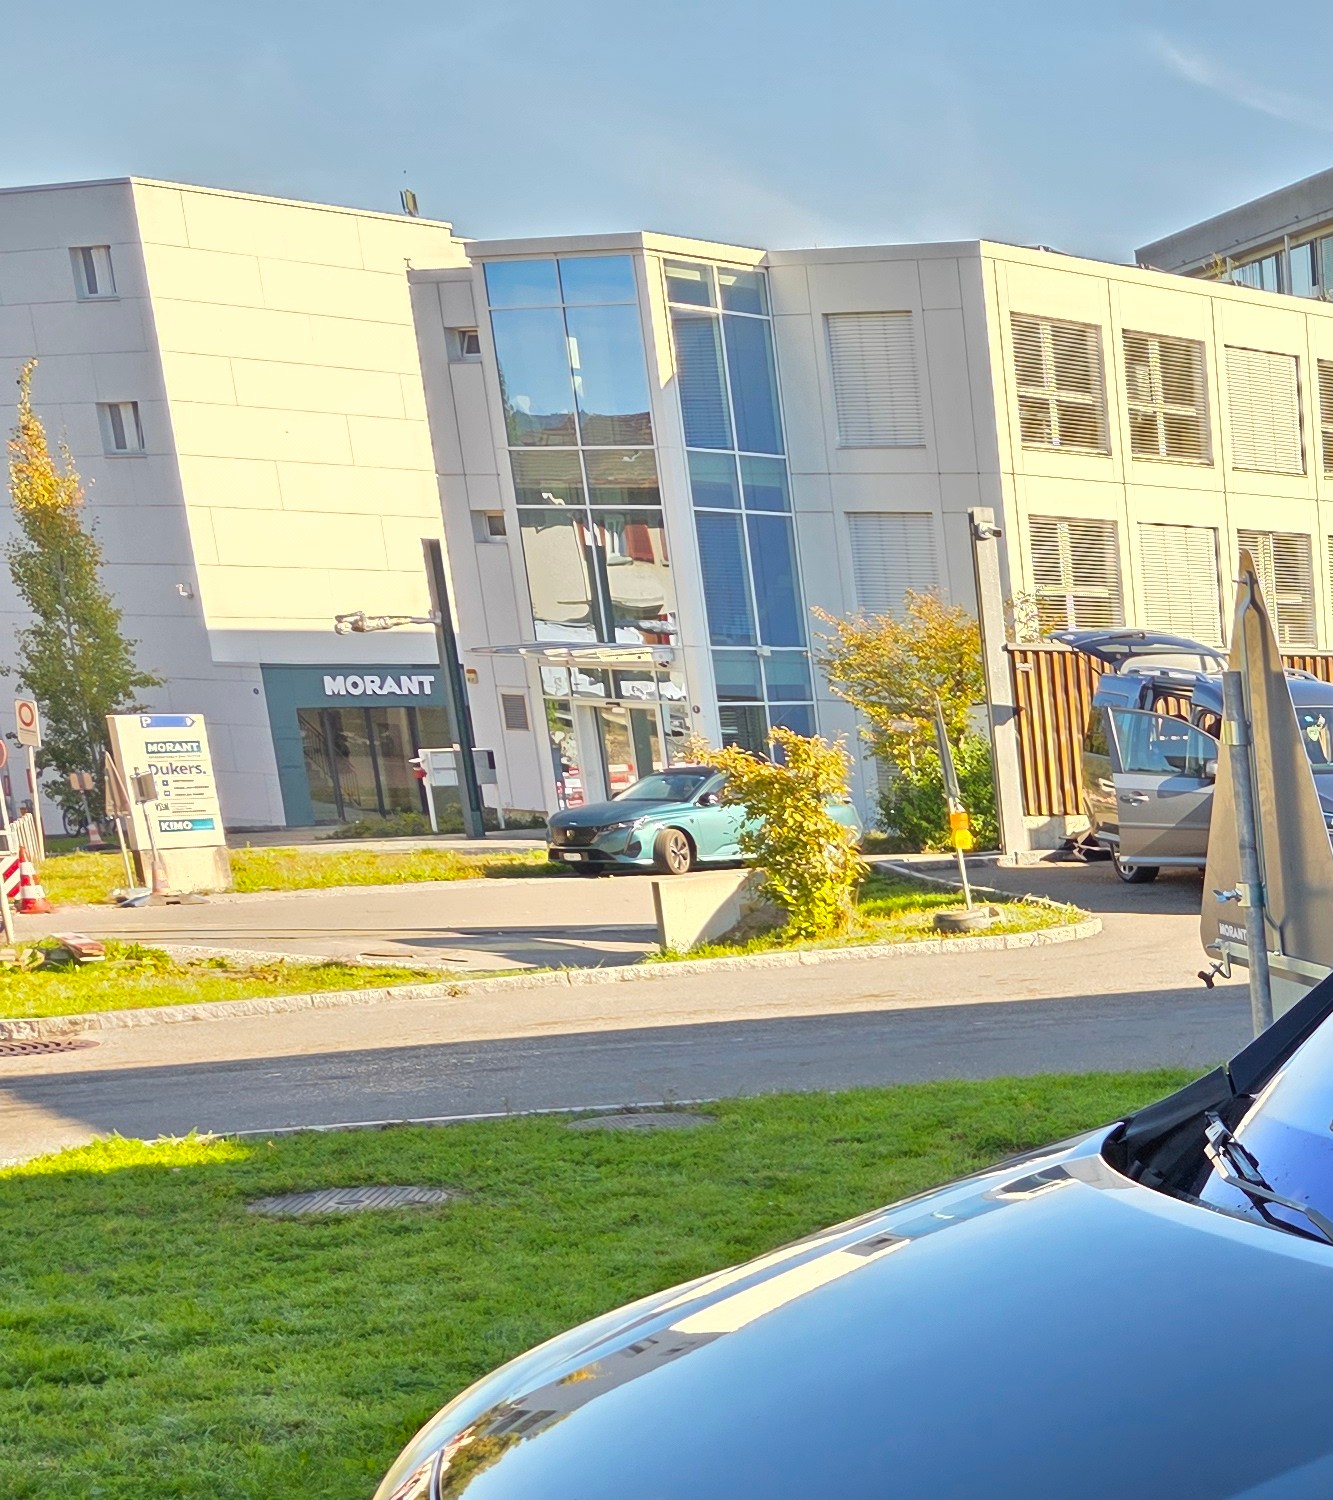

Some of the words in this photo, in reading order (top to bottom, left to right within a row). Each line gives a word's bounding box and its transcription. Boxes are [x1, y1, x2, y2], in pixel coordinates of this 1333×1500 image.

[323, 675, 435, 695] MORANT
[141, 716, 152, 728] P
[147, 742, 199, 752] MORANT
